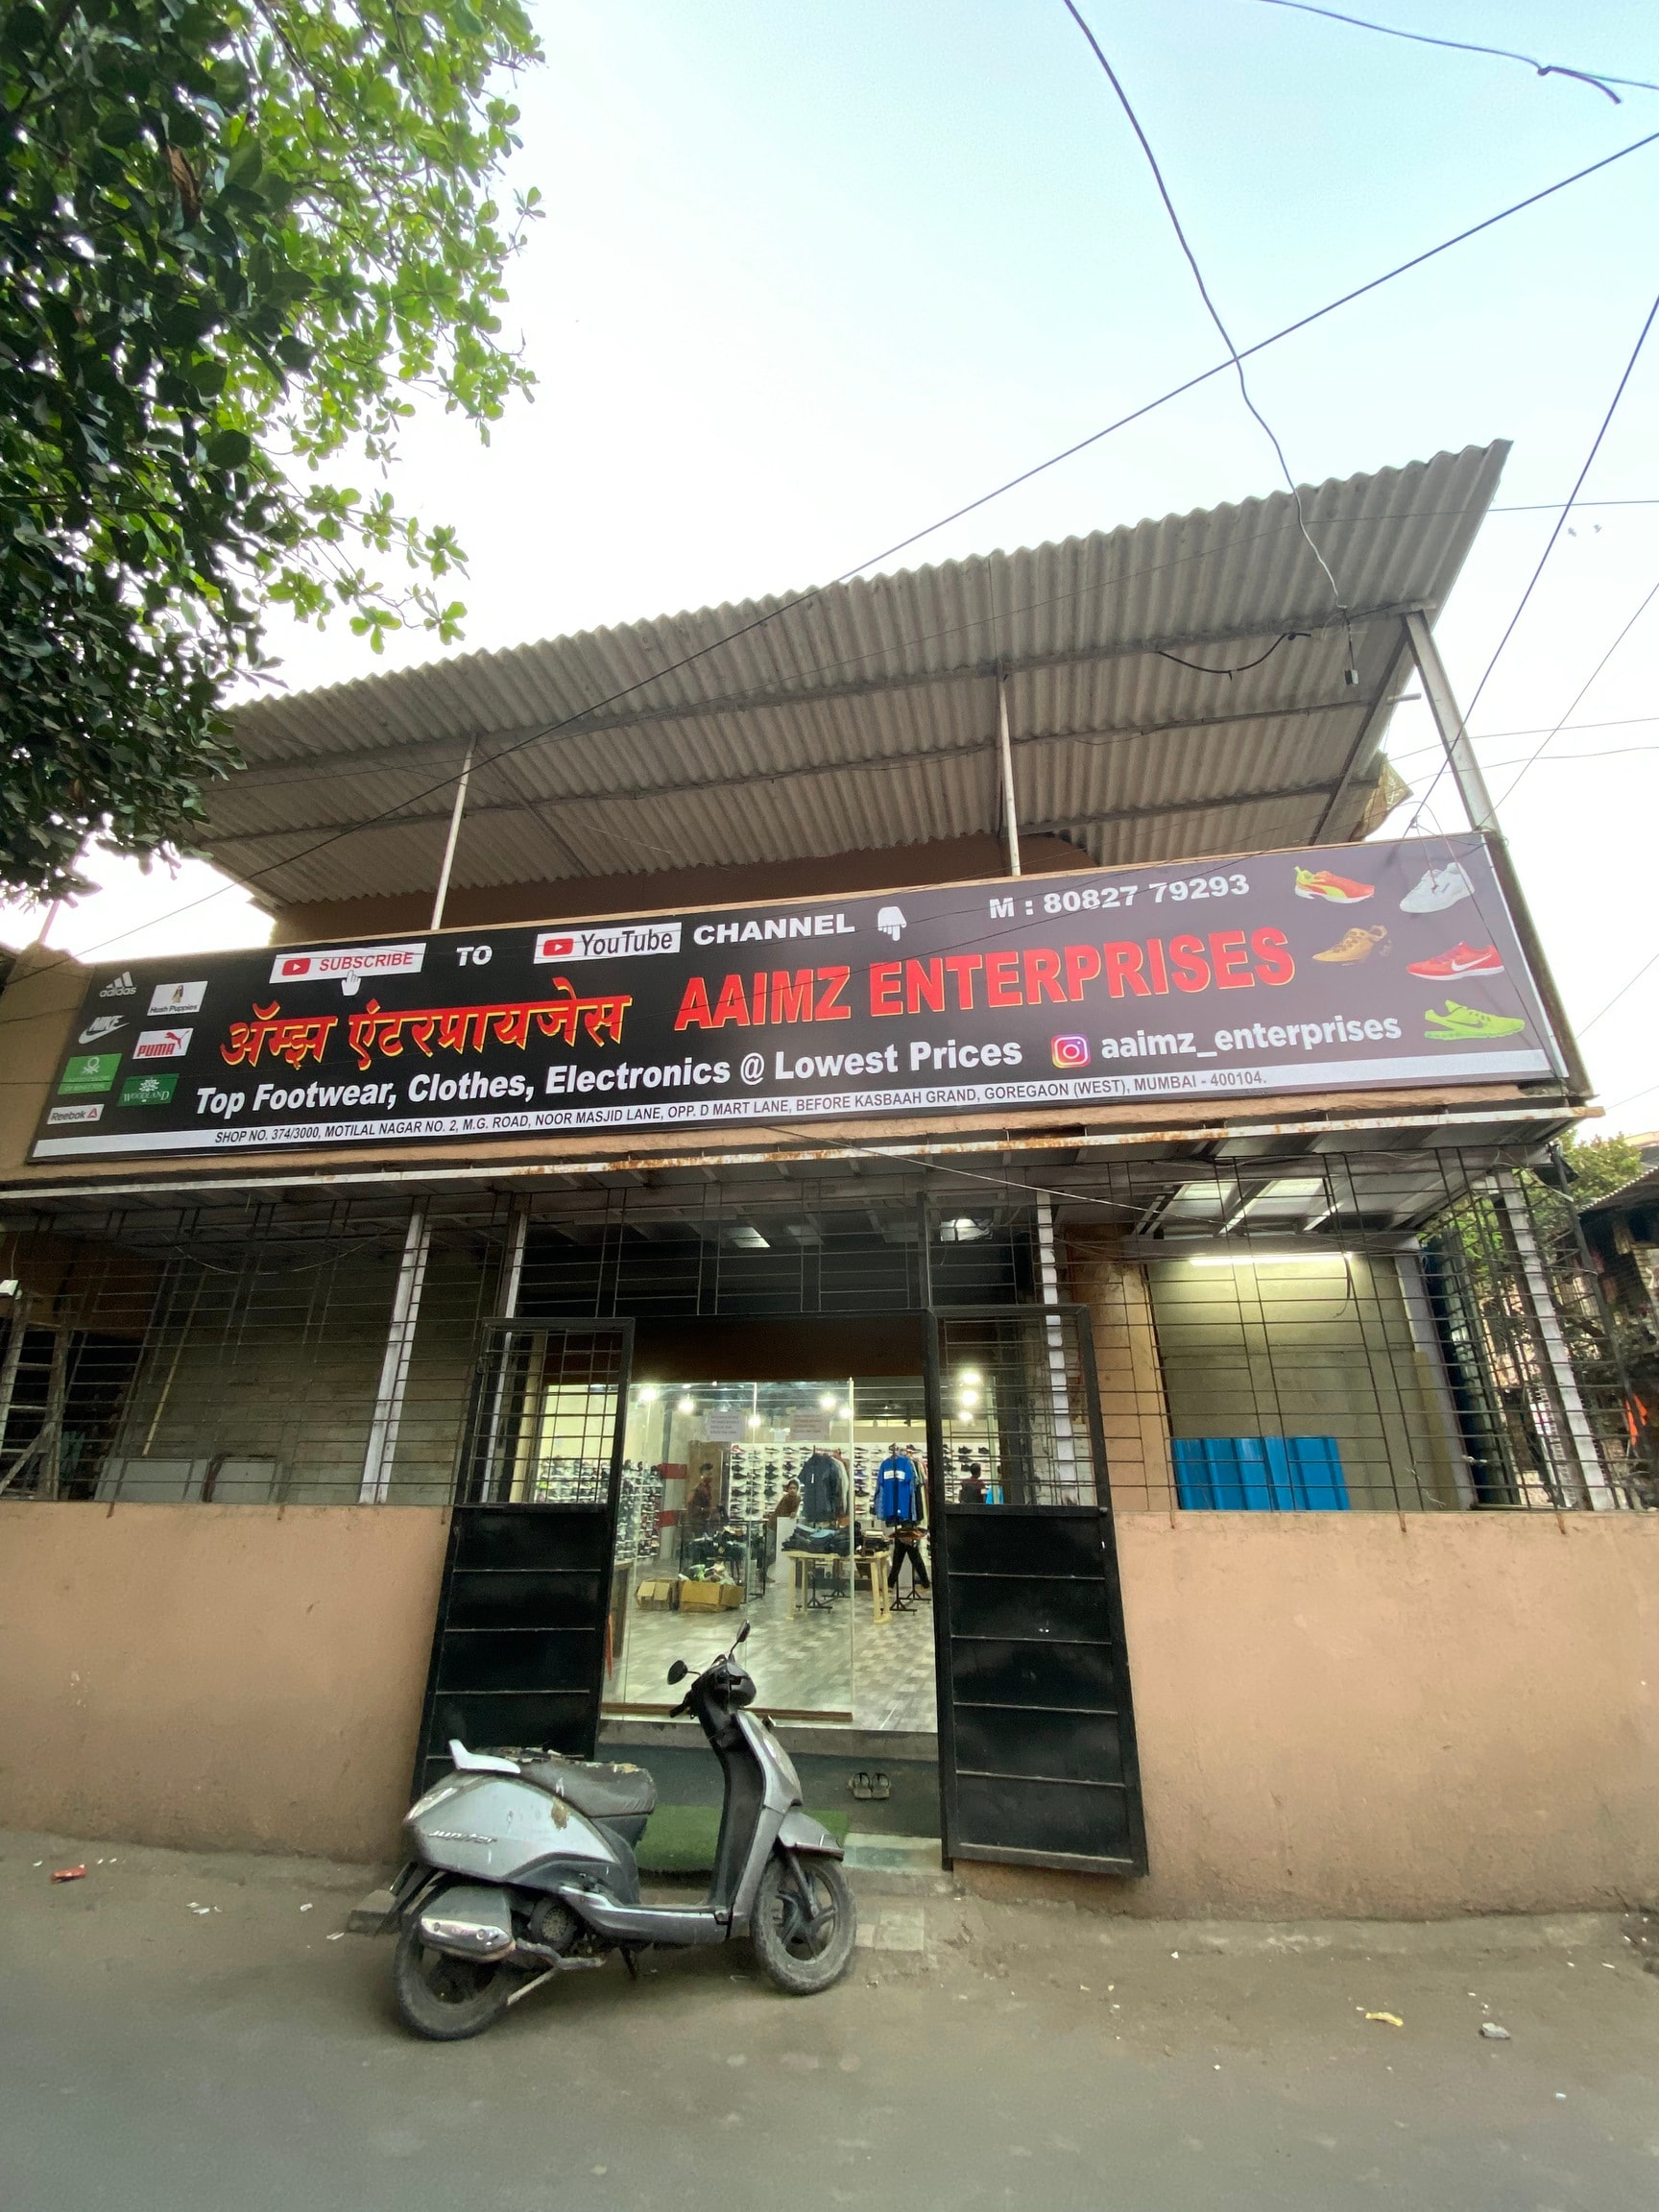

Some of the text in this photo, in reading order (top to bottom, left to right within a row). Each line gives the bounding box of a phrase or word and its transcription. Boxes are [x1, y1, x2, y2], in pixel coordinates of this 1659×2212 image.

[989, 897, 1015, 919] M
[1044, 884, 1139, 914] 80827
[1149, 874, 1250, 904] 79293
[319, 913, 855, 972] SUBSCRIBE TO YouTube CHANNEL
[99, 986, 137, 998] adidas
[674, 926, 1296, 1031] AAIMZ ENTERPRISES
[89, 1015, 125, 1032] NIKE
[170, 1004, 199, 1013] Puppies
[136, 1043, 176, 1057] PUMA
[1101, 1015, 1403, 1059] aaimz_enterprises
[196, 1039, 1022, 1119] Top Footwear, Clothes, Electronics @ Lowest Prices
[123, 1090, 170, 1103] WOODLAND
[215, 1131, 247, 1143] SHOP
[249, 1129, 269, 1142] NO.
[272, 1126, 321, 1141] 374/3000,
[325, 1123, 376, 1139] MOTILAL
[379, 1121, 422, 1135] NAGAR
[425, 1120, 445, 1133] NO.
[448, 1119, 459, 1133] 2,
[463, 1118, 489, 1131] M.G.
[493, 1116, 531, 1129] ROAD,
[535, 1114, 572, 1126] NOOR
[576, 1110, 623, 1124] MASJID
[626, 1107, 663, 1121] LANE,
[667, 1105, 696, 1118] OPP.
[700, 1104, 709, 1117] D
[712, 1101, 750, 1116] MART
[754, 1099, 792, 1115] LANE,
[796, 1096, 851, 1112] BEFORE
[854, 1092, 922, 1108] KASBAAH
[926, 1089, 980, 1104] GRAND,
[984, 1084, 1070, 1099] GOREGAON
[1073, 1079, 1131, 1097] (WEST),
[1134, 1074, 1197, 1092] MUMBAI
[1211, 1070, 1267, 1087] 400104.
[51, 1109, 86, 1121] Reebok
